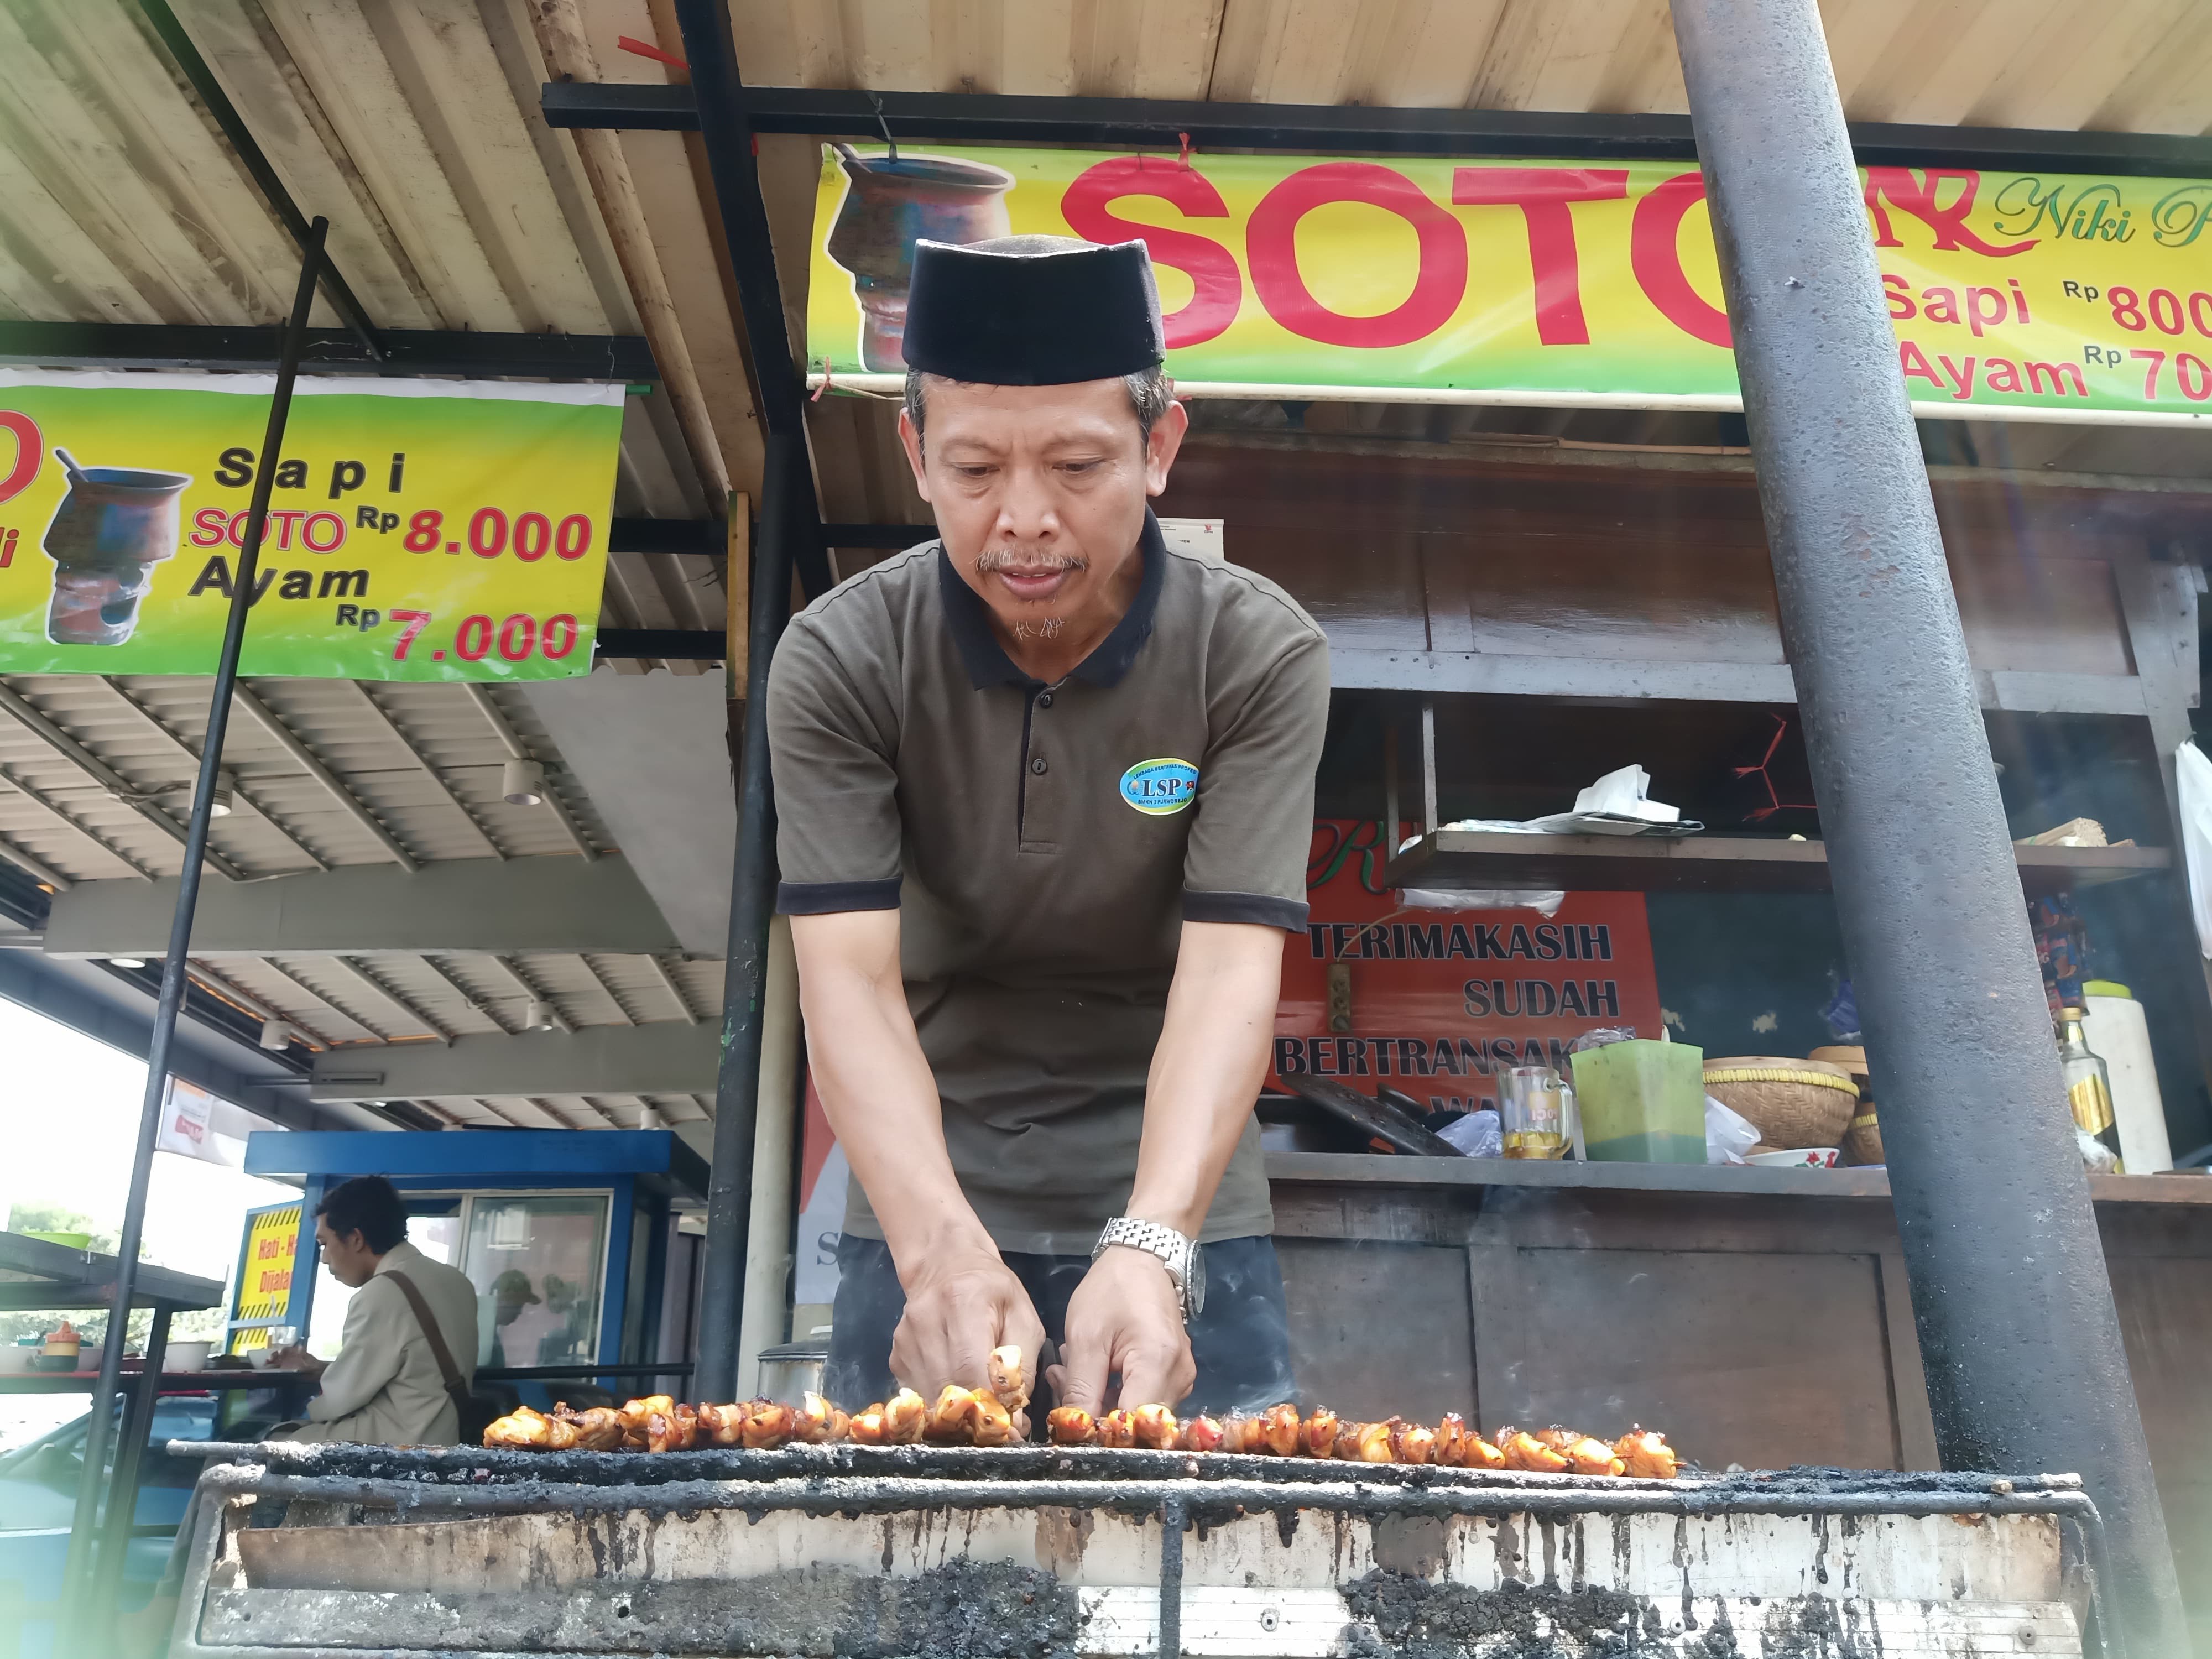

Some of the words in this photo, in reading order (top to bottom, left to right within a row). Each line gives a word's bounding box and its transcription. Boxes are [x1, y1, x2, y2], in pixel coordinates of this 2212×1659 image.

[1881, 274, 2030, 337] Sapi
[2062, 280, 2099, 303] Rp
[1900, 341, 2089, 399] Ayam
[2084, 345, 2121, 368] Rp
[214, 447, 405, 499] Sapi
[189, 507, 347, 554] SOTO
[356, 505, 400, 534] Rp
[403, 507, 592, 562] 8.000
[336, 604, 380, 632] Rp
[389, 609, 578, 662] 7.000
[1142, 779, 1181, 797] LSP
[1178, 764, 1197, 774] PROFESI
[1307, 922, 1612, 961] TERIMAKASIH
[1463, 979, 1620, 1018] SUDAH
[258, 1236, 280, 1260] Hati
[259, 1269, 292, 1293] Dijala
